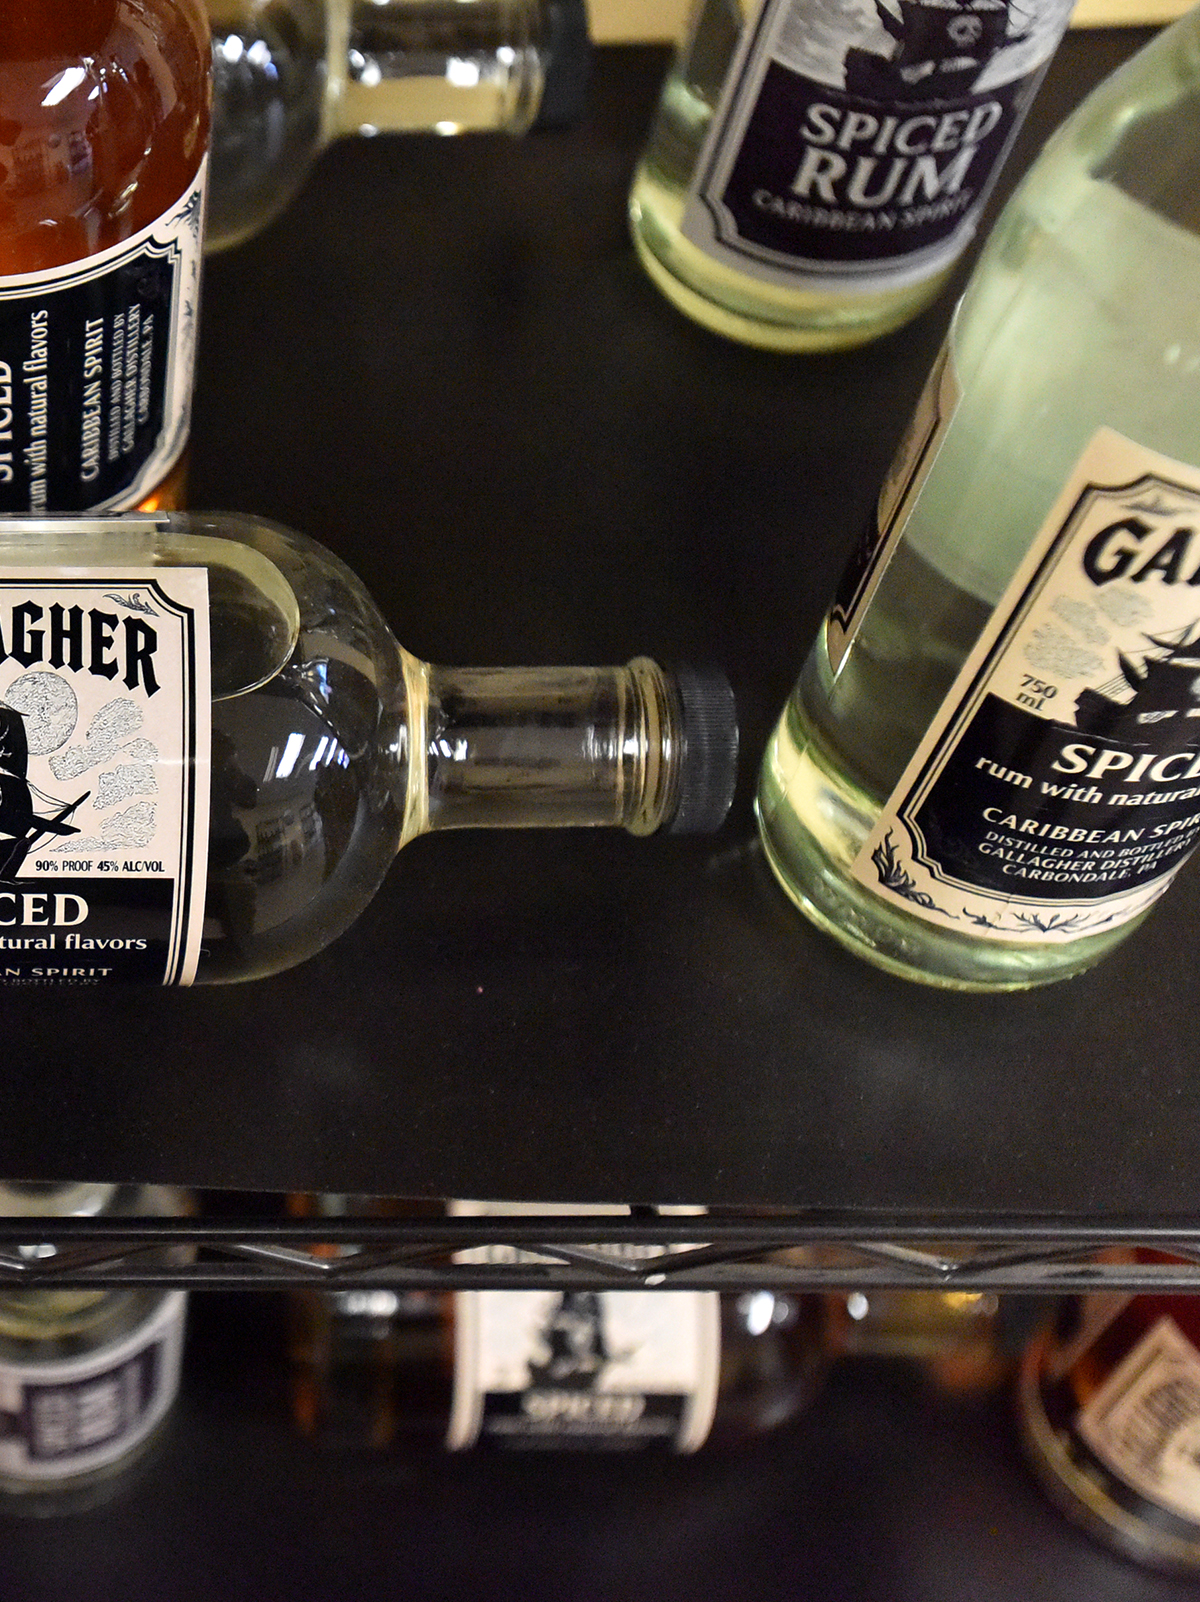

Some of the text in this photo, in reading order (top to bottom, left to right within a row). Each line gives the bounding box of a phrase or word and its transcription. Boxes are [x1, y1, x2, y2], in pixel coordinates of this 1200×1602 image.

[799, 101, 1003, 156] SPICED
[791, 145, 979, 209] RUM
[22, 309, 49, 374] flavors
[23, 374, 49, 437] natural
[80, 317, 104, 482] CARIBBEAN SPIRIT
[23, 439, 49, 477] with
[1020, 673, 1057, 699] 750
[974, 757, 1033, 789] rum
[1041, 783, 1103, 804] with
[982, 807, 1146, 844] CARIBBEAN
[978, 842, 1096, 871] GALLAGHER
[985, 831, 1075, 858] DISTILLED
[1078, 849, 1115, 859] AND
[1117, 834, 1184, 858] BOTTLED
[35, 859, 166, 873] 90% PROOF 45% ALC/VOL
[64, 933, 148, 950] flavors
[31, 967, 113, 977] SPIRIT
